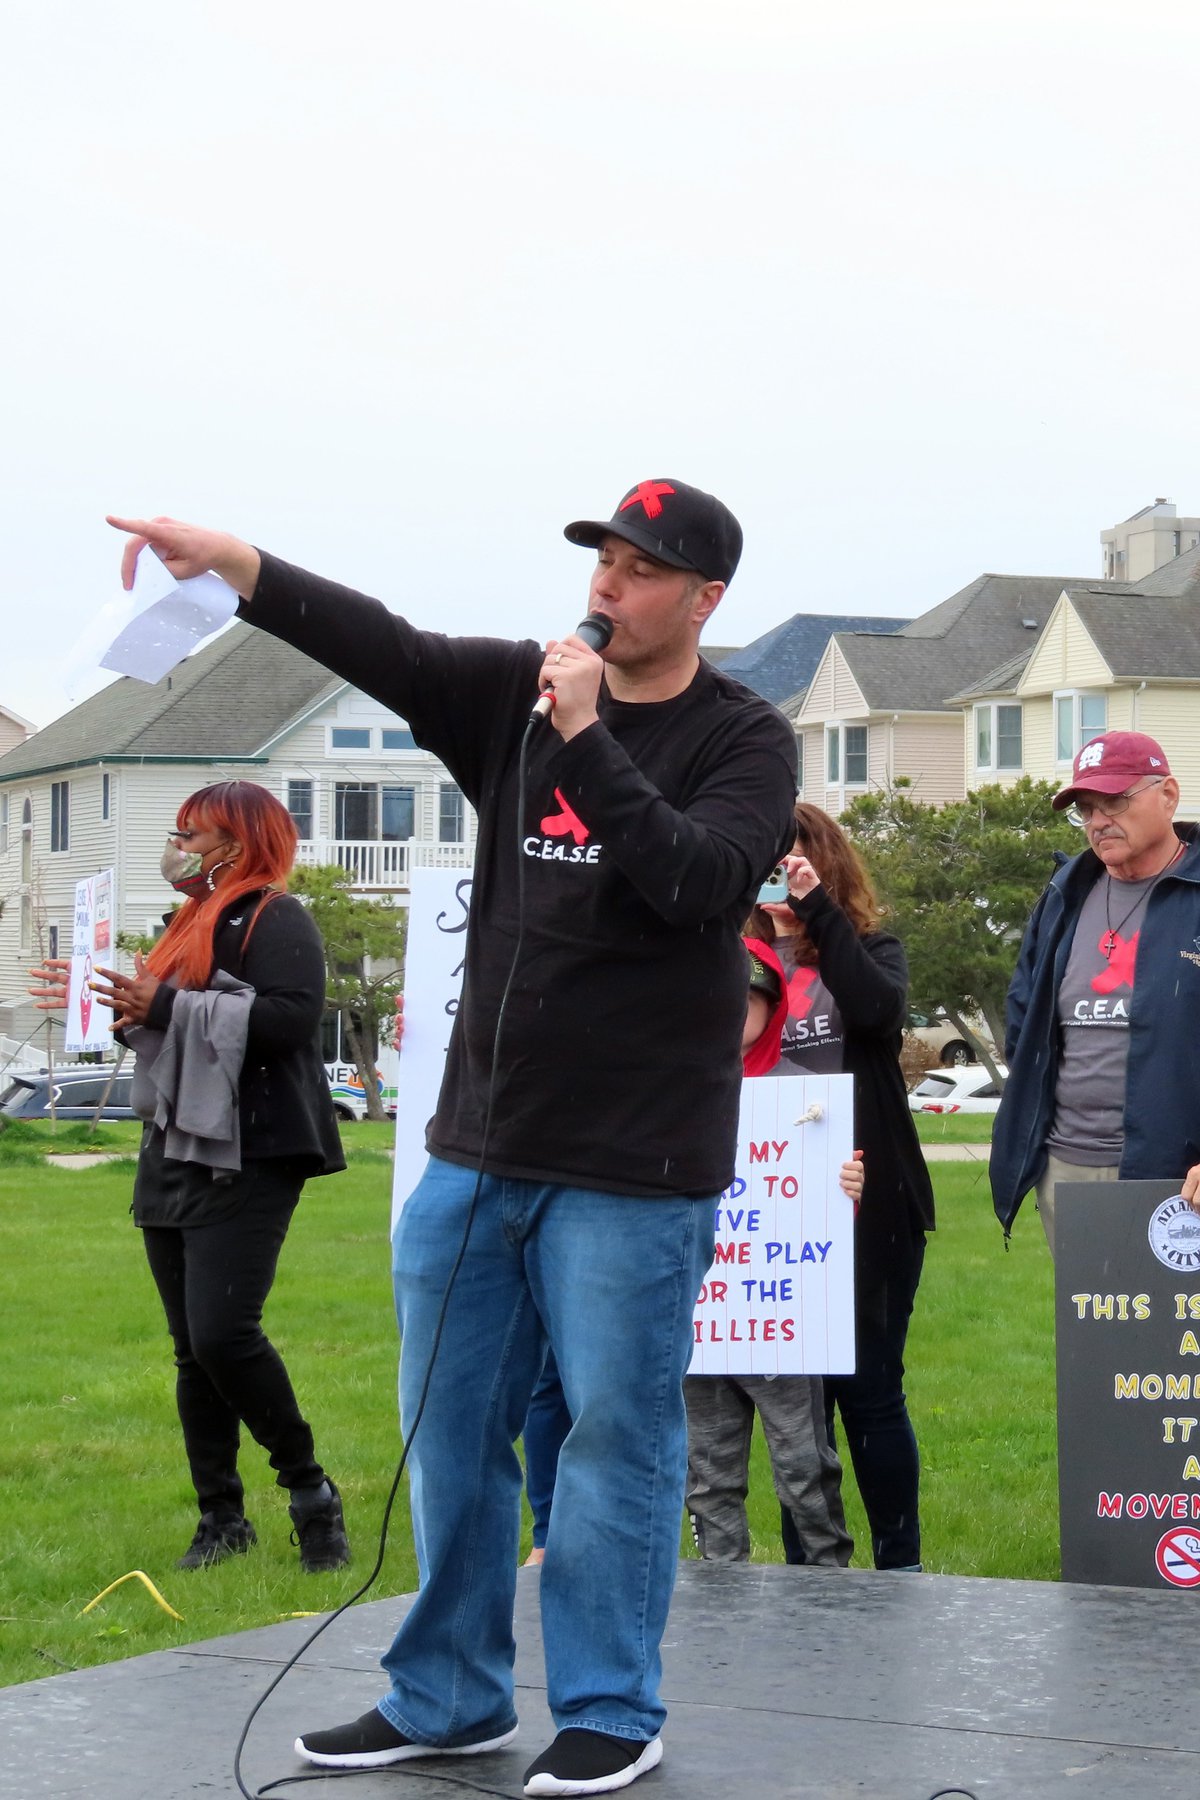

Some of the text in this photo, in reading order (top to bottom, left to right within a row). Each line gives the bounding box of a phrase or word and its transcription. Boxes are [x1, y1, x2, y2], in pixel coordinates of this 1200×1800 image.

[797, 1041, 819, 1049] Smoking
[326, 1068, 360, 1082] NEY
[749, 1140, 789, 1163] MY
[763, 1175, 799, 1198] TO
[715, 1209, 760, 1232] IVE
[765, 1241, 833, 1264] PLAY
[741, 1278, 793, 1302] THE
[1071, 1293, 1151, 1321] THIS
[693, 1319, 795, 1343] ILLIES
[1178, 1330, 1200, 1356] A
